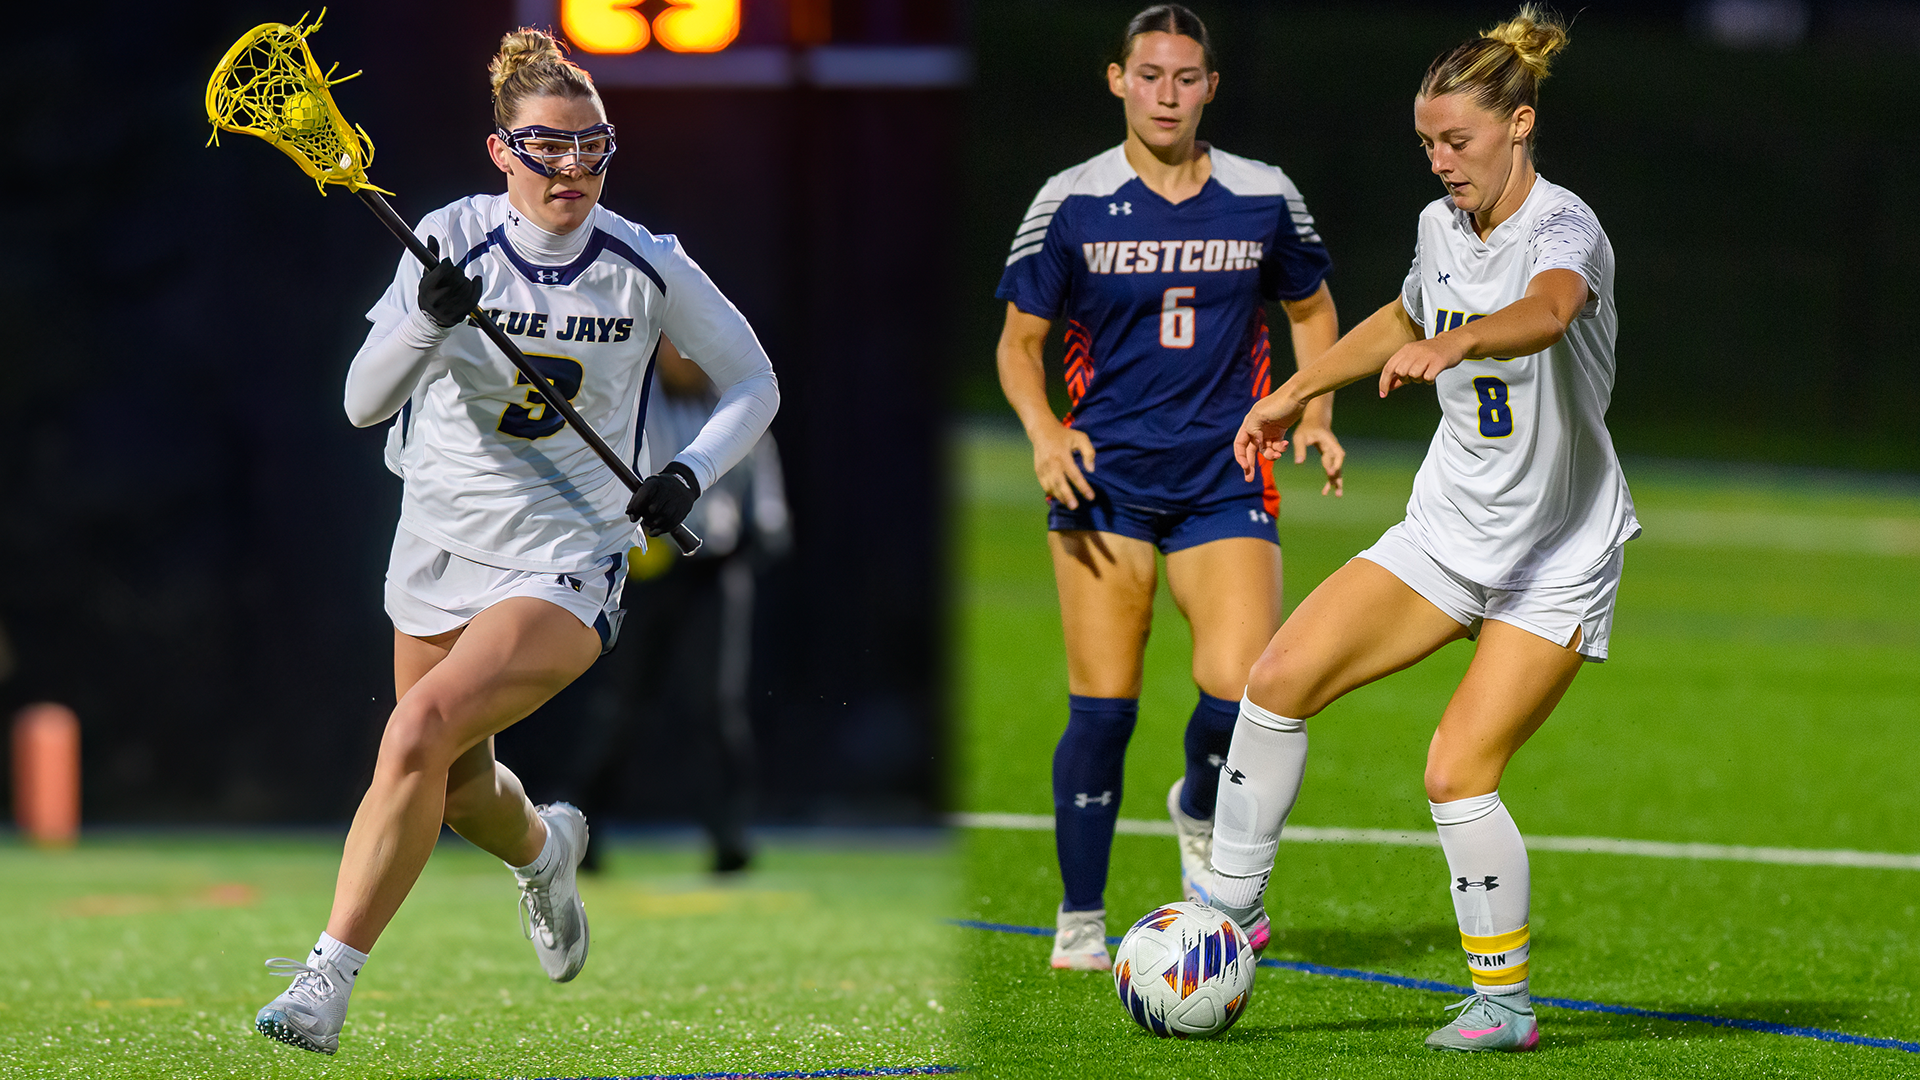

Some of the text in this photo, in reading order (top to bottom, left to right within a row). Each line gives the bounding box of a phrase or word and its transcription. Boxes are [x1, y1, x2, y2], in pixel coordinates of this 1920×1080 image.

[498, 127, 511, 146] STX
[556, 315, 634, 343] JAYS
[1159, 286, 1196, 349] 6
[496, 351, 584, 441] 3
[1471, 375, 1514, 439] 8
